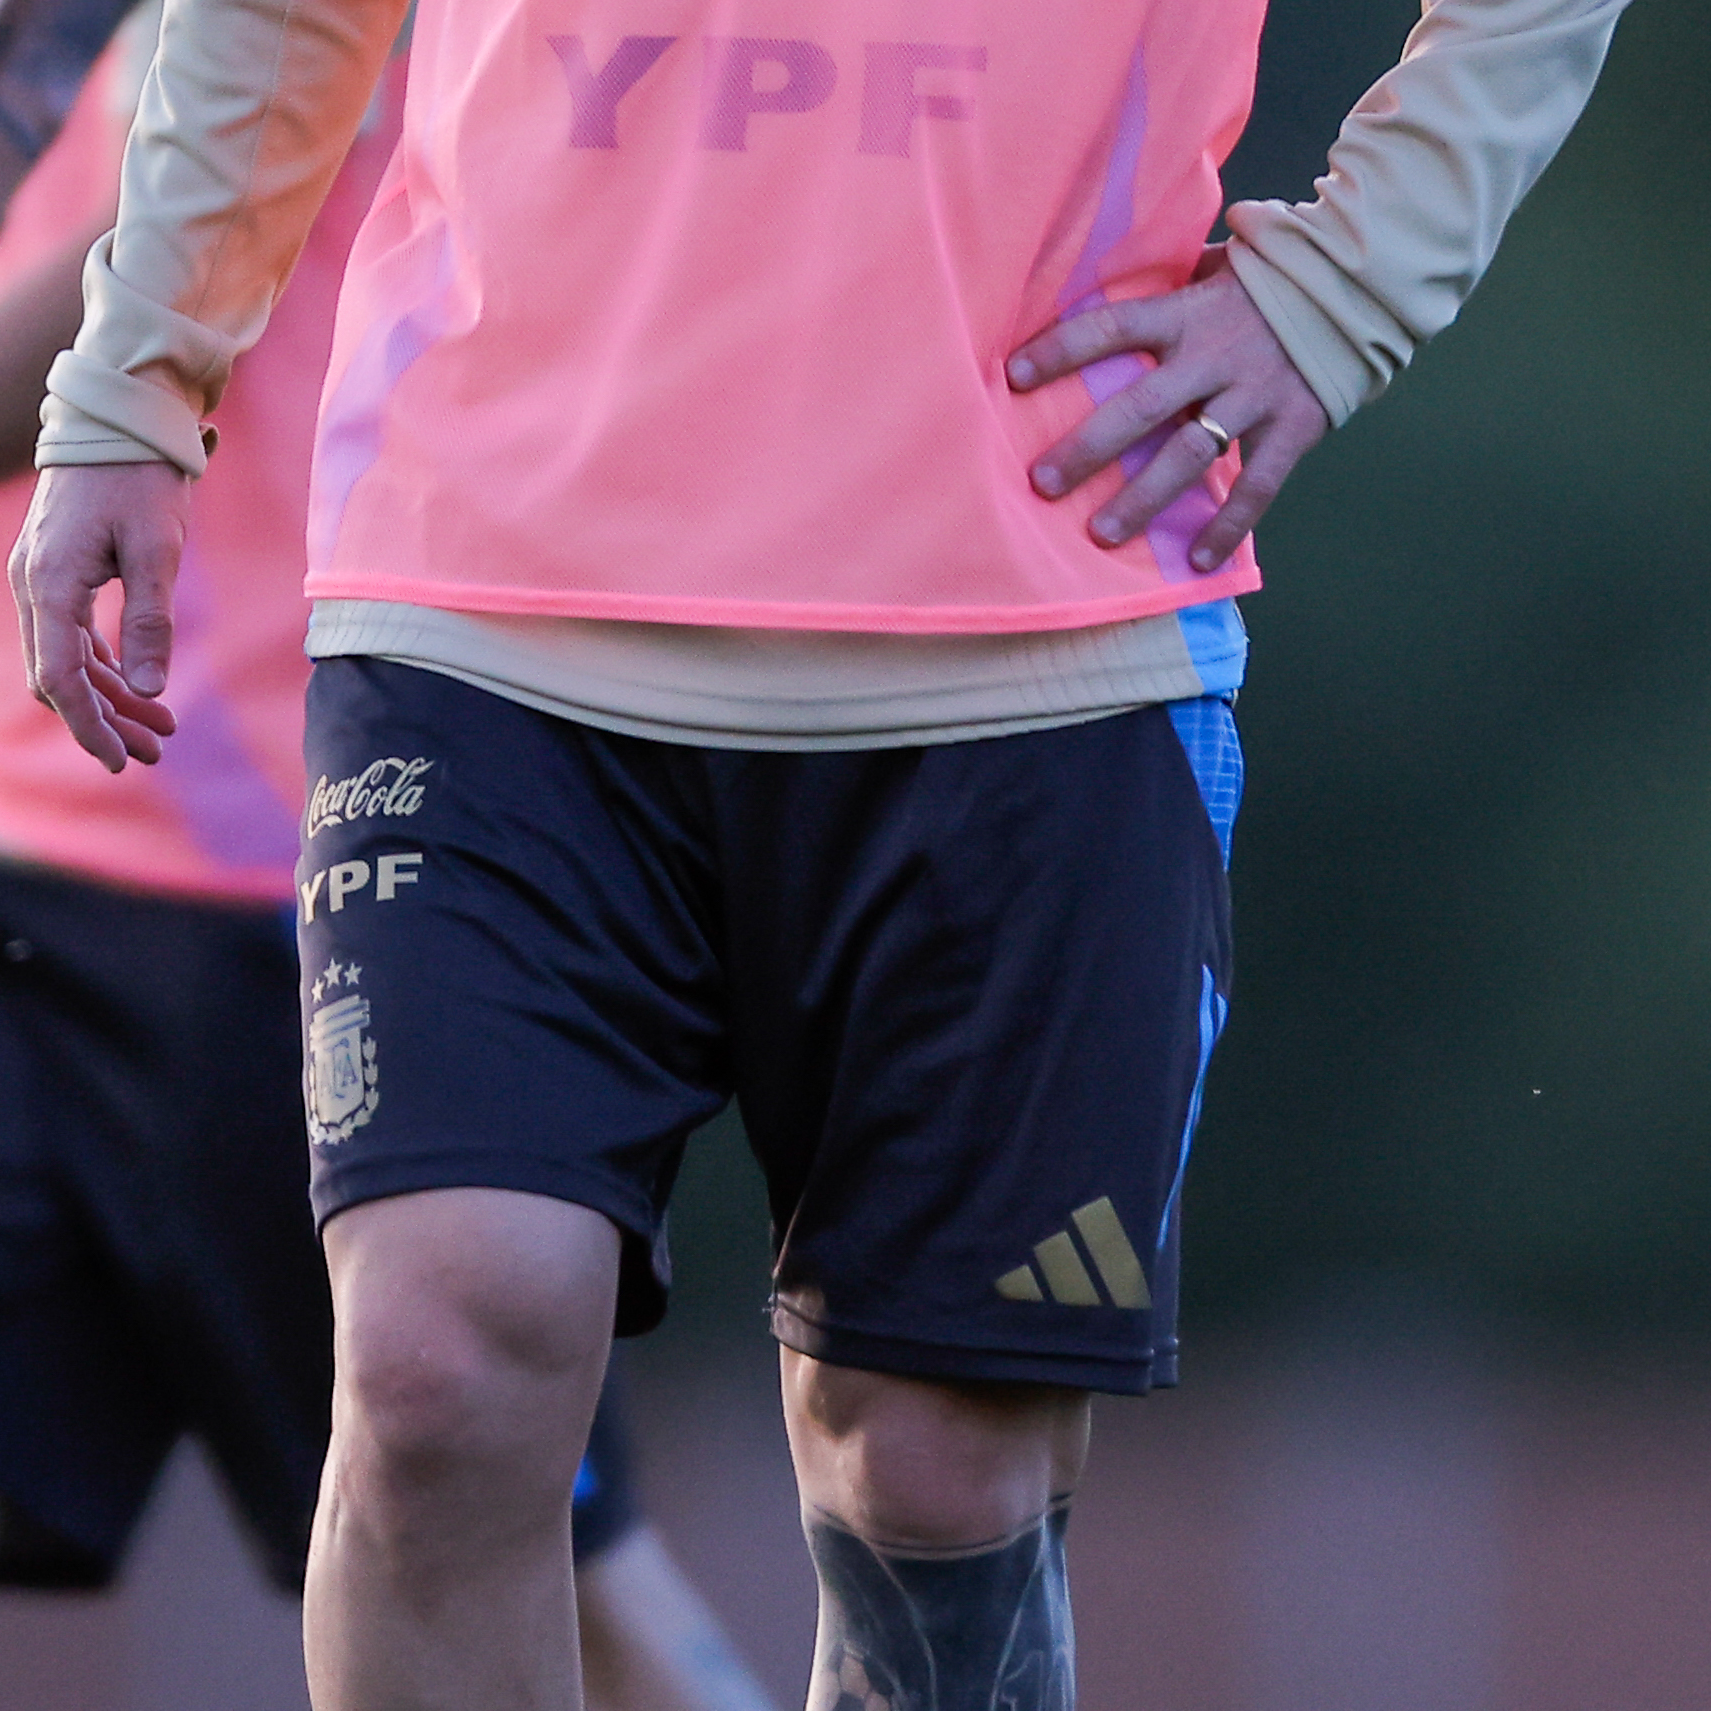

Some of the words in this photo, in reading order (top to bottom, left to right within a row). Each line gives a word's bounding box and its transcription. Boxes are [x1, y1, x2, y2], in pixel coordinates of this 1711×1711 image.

[543, 34, 988, 158] YPF
[307, 756, 435, 841] Coca-Cola
[300, 852, 424, 926] YPF
